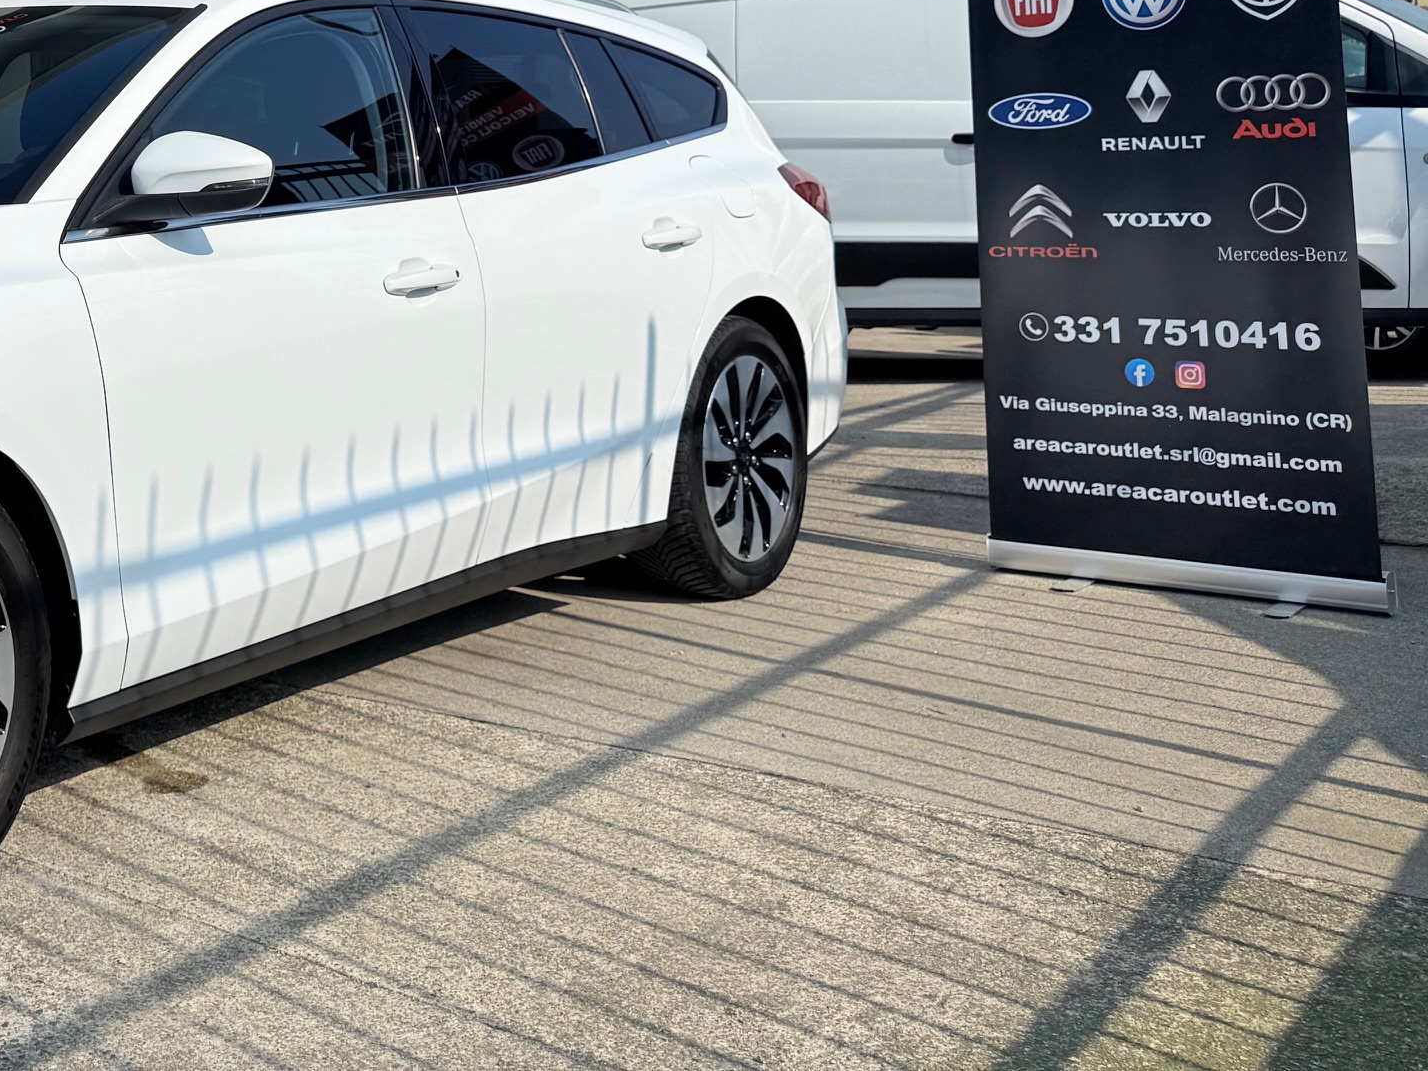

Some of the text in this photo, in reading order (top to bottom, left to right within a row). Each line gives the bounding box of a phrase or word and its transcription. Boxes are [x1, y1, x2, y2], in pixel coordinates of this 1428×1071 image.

[1008, 98, 1070, 124] Ford
[1101, 134, 1206, 152] RENAULT
[1103, 211, 1212, 228] VOLVO
[1217, 246, 1348, 263] Mercedes-Benz
[1053, 315, 1322, 352] 331 7510416
[999, 395, 1353, 433] Via Giuseppina 33, Malagnino (CR)
[1012, 435, 1343, 474] areacaroutlet.srl@gmail.com
[1022, 475, 1337, 517] www.areacaroutlet.com
